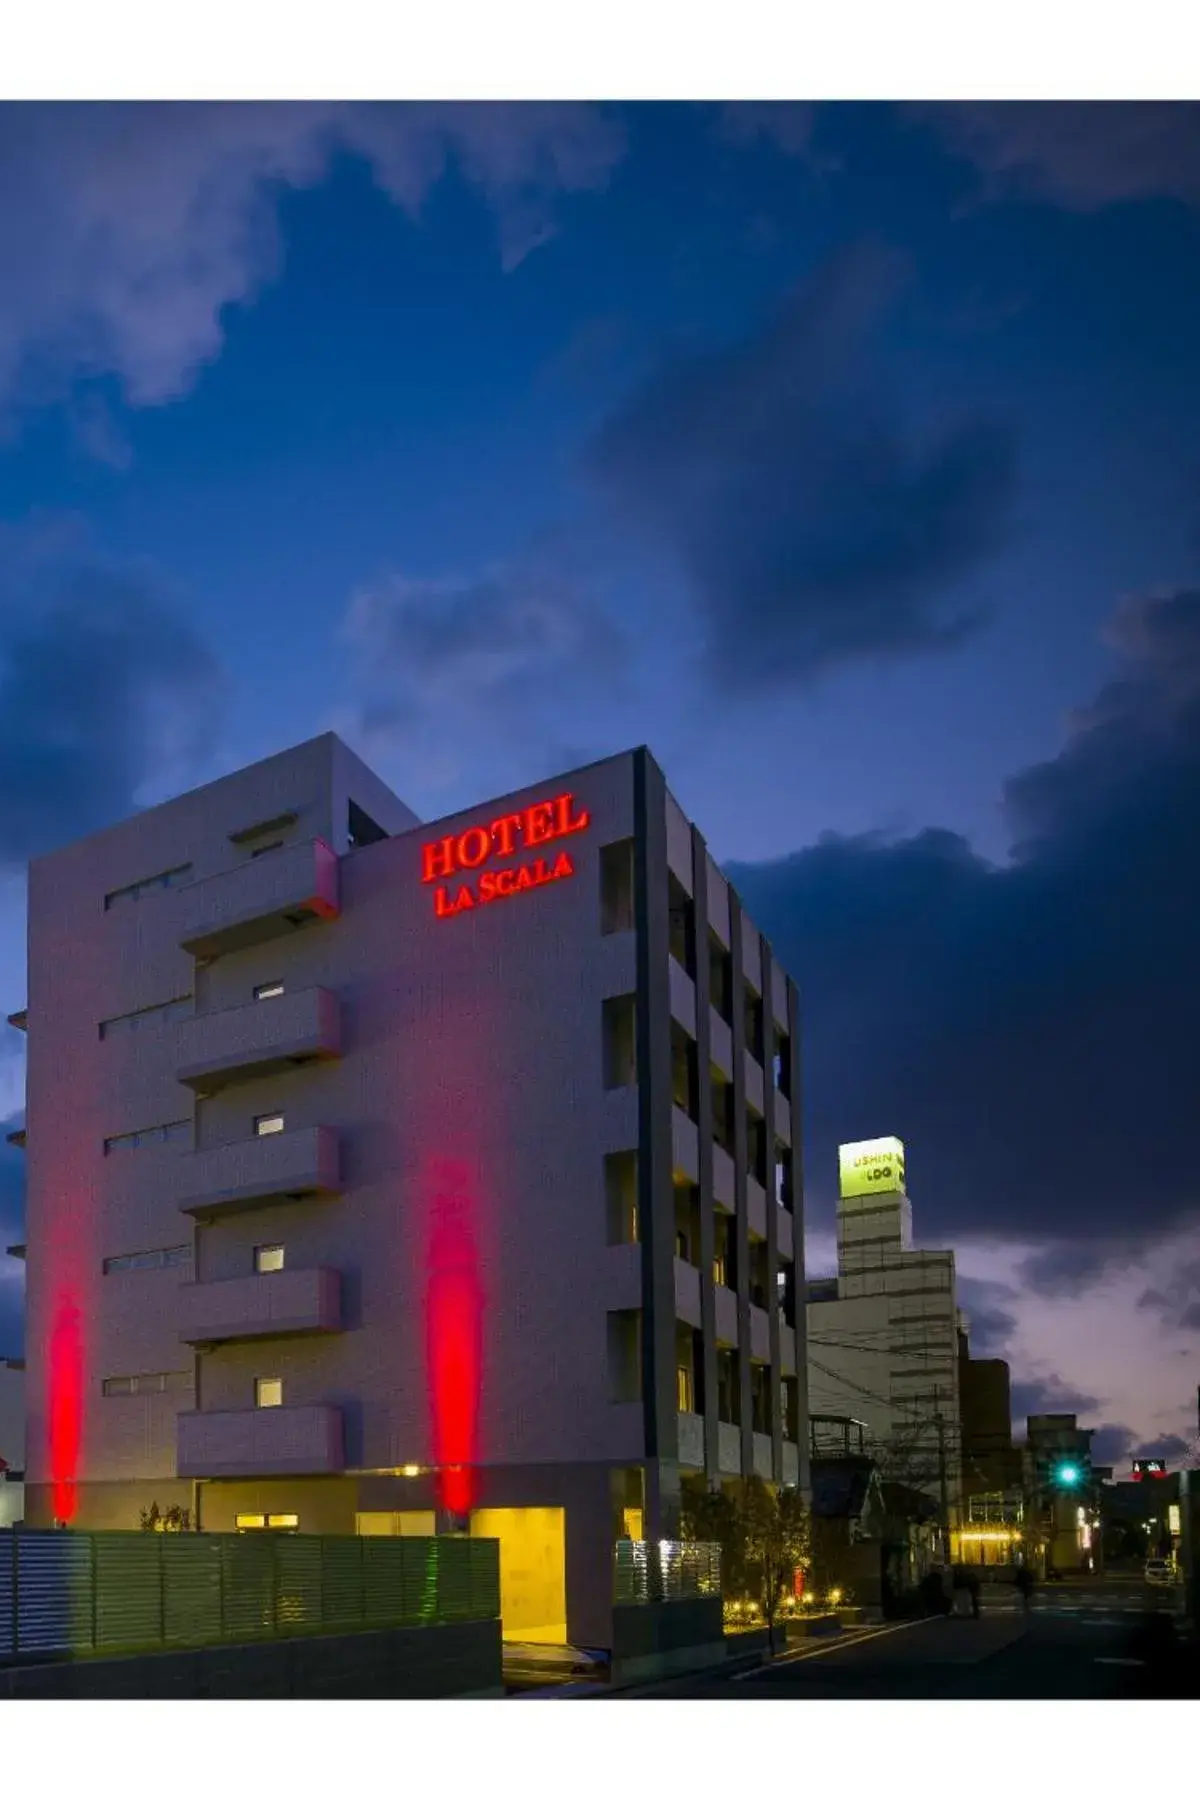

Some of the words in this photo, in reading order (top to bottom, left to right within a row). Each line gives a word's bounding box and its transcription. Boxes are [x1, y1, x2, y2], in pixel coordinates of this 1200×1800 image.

[421, 792, 588, 883] HOTEL
[434, 884, 475, 918] LA
[477, 852, 573, 902] SCALA
